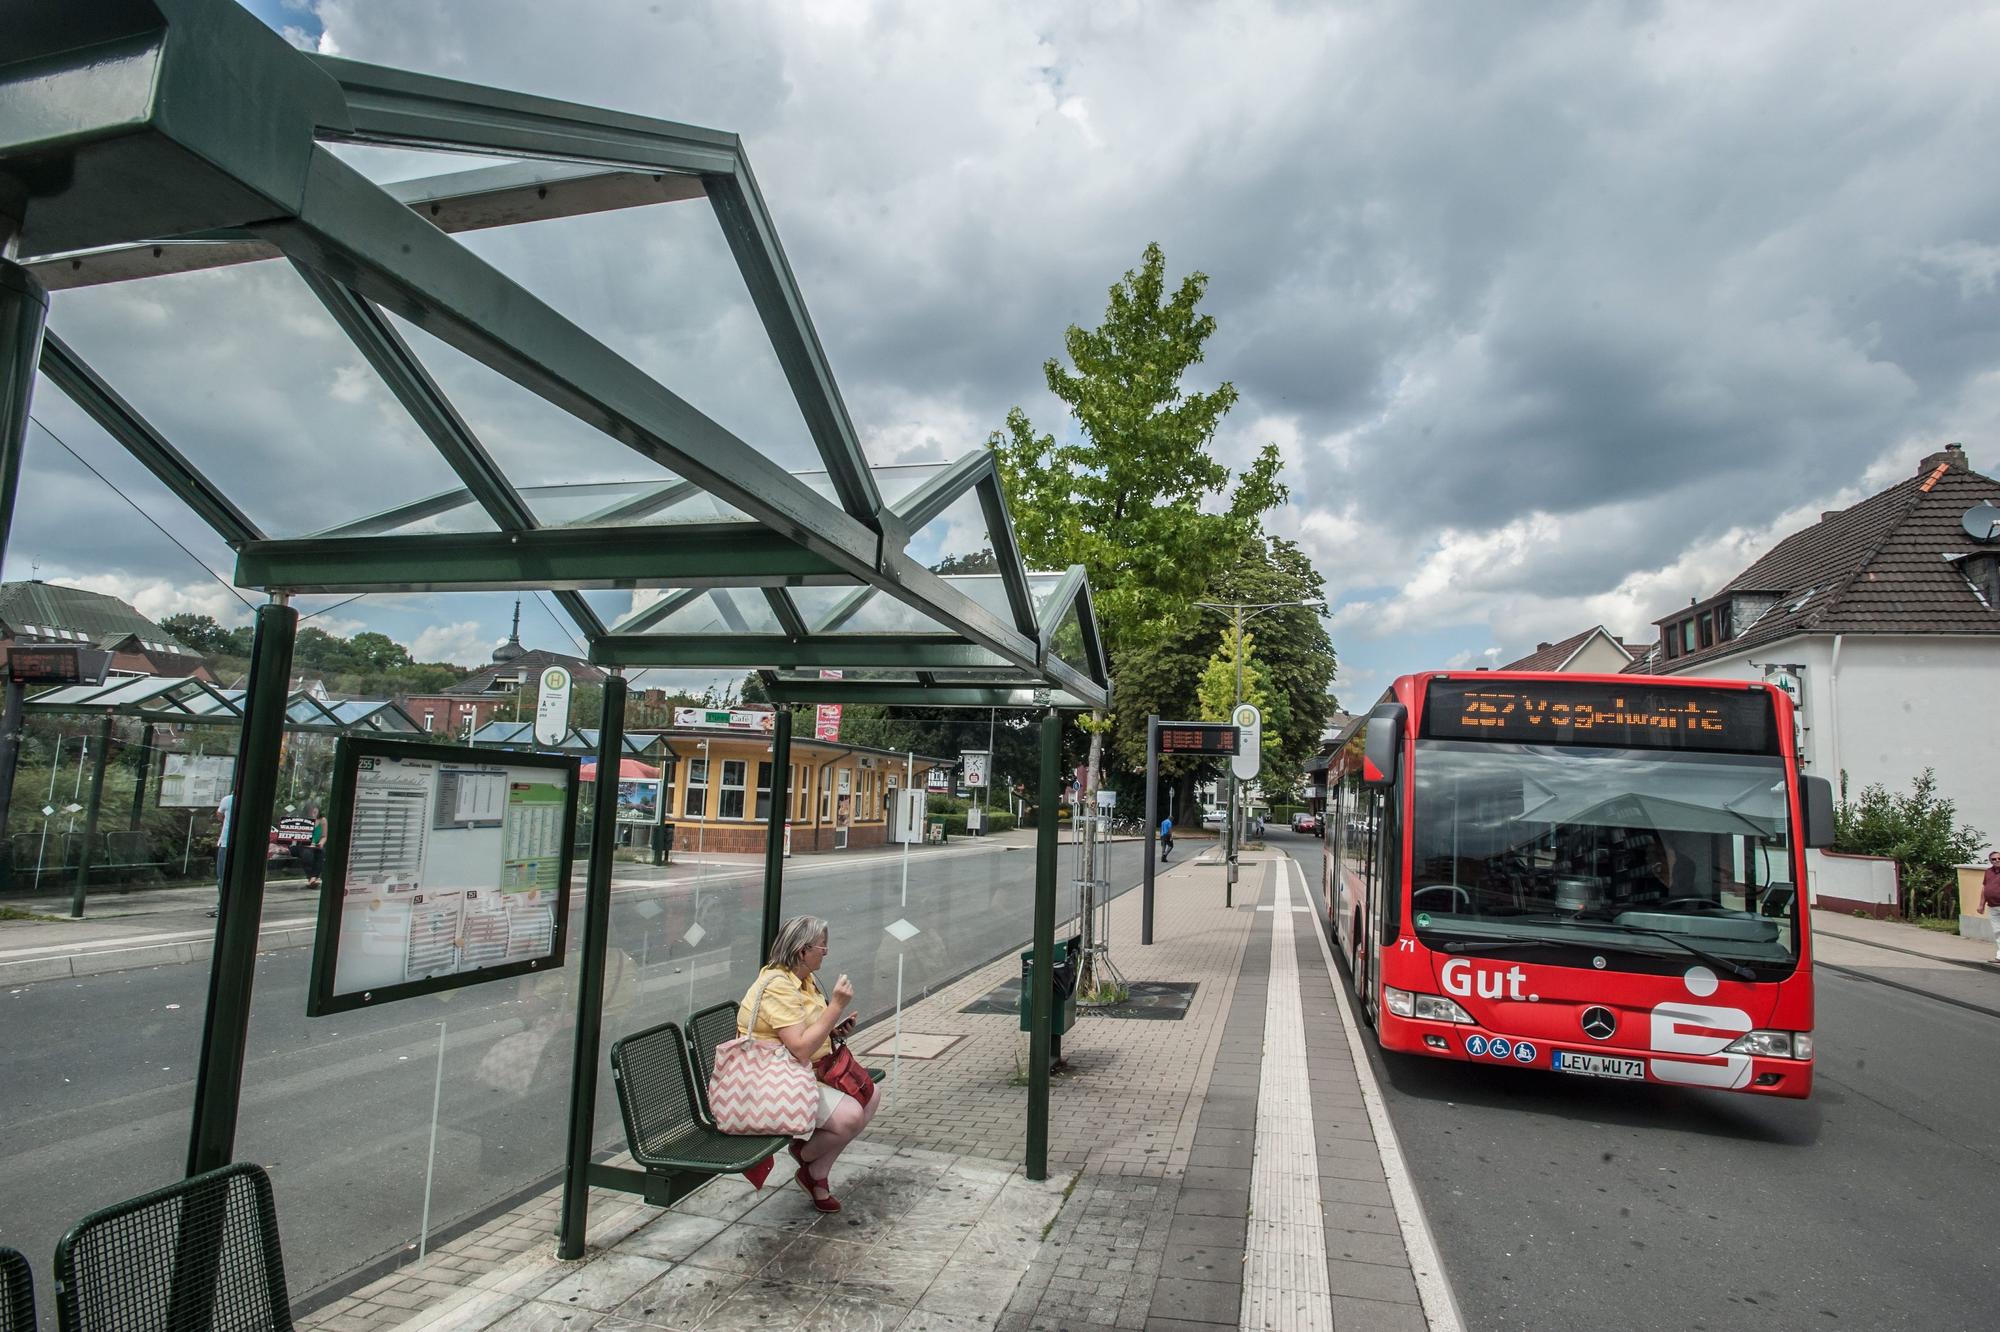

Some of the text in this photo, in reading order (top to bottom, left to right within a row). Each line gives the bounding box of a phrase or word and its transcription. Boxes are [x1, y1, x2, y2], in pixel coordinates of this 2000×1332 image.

[358, 759, 373, 769] 255
[1400, 938, 1415, 952] 71
[1441, 958, 1540, 1002] Gut.
[1561, 1054, 1592, 1071] LEV
[1624, 1061, 1643, 1077] 71
